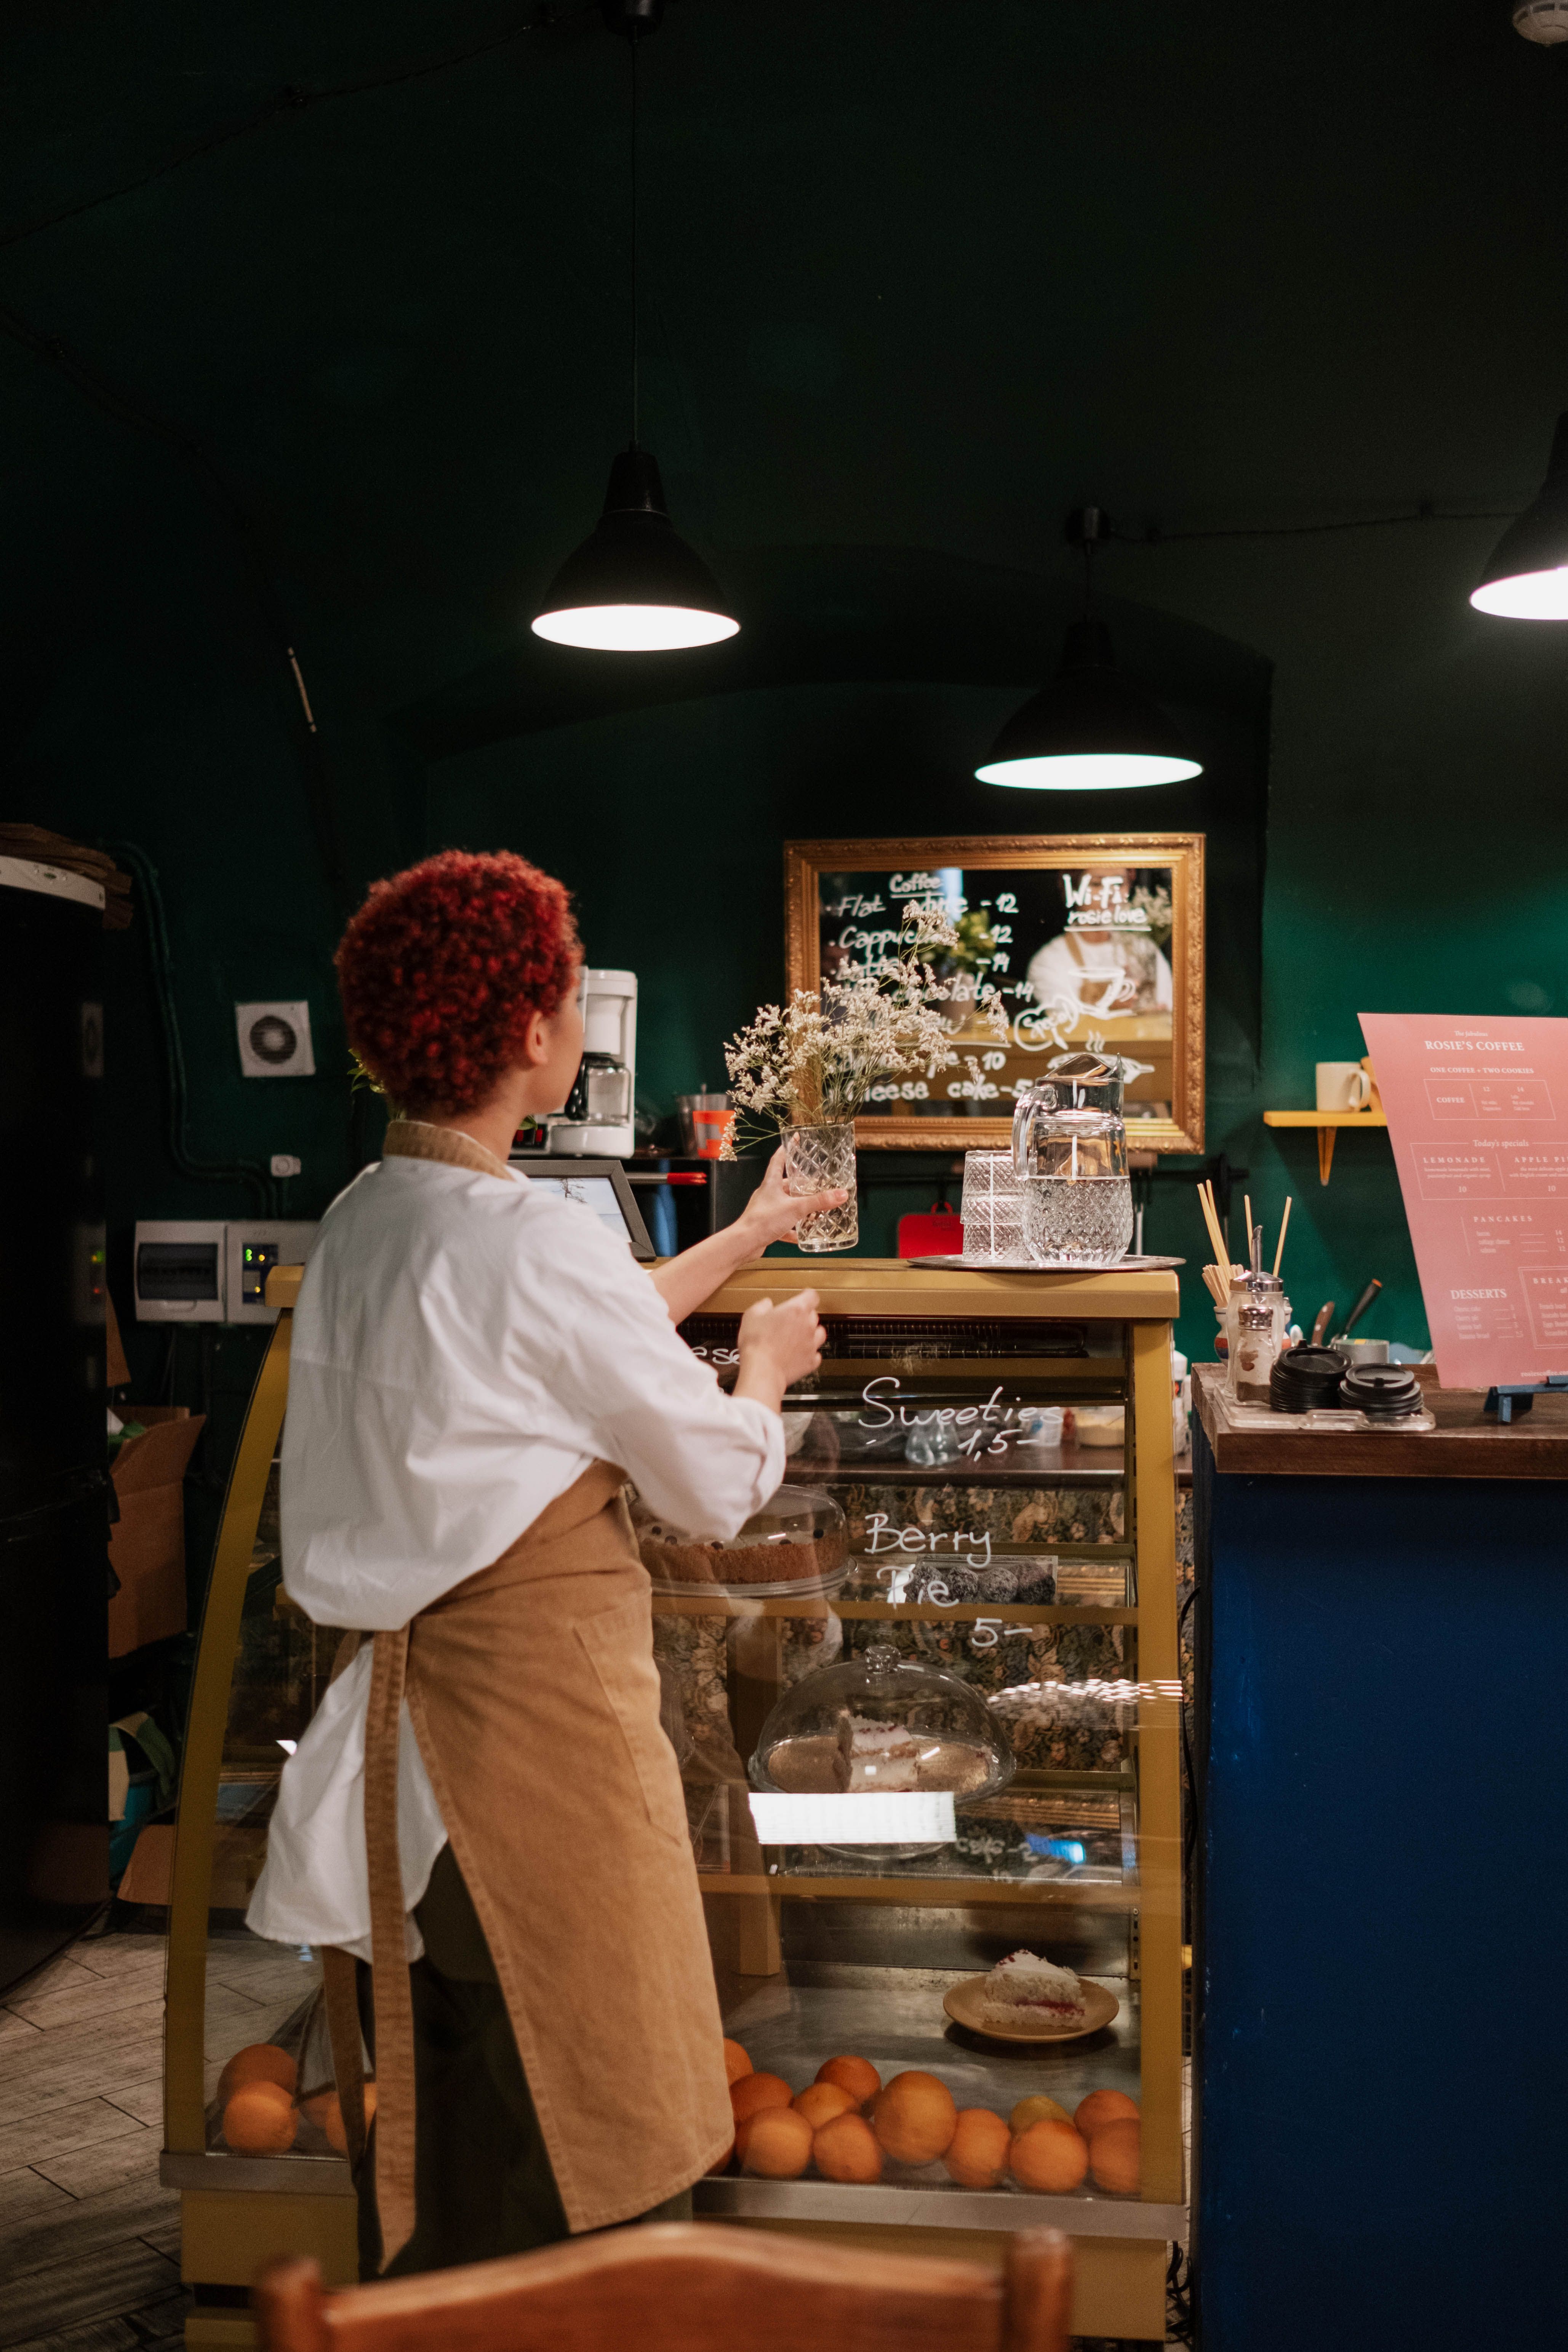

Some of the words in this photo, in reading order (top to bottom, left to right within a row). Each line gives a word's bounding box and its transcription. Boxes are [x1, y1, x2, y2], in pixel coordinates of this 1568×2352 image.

[889, 872, 944, 893] Coffee
[838, 893, 886, 918] Flat
[1424, 1040, 1474, 1050] ROSIE'S
[1475, 1042, 1525, 1051] COFFEE
[947, 1074, 1000, 1101] cake
[1472, 1139, 1500, 1148] Today's
[1501, 1139, 1529, 1148] specials
[1450, 1289, 1507, 1299] DESSERTS
[858, 1377, 1064, 1428] Sweeties
[864, 1513, 992, 1568] Berry
[877, 1566, 959, 1609] Pie
